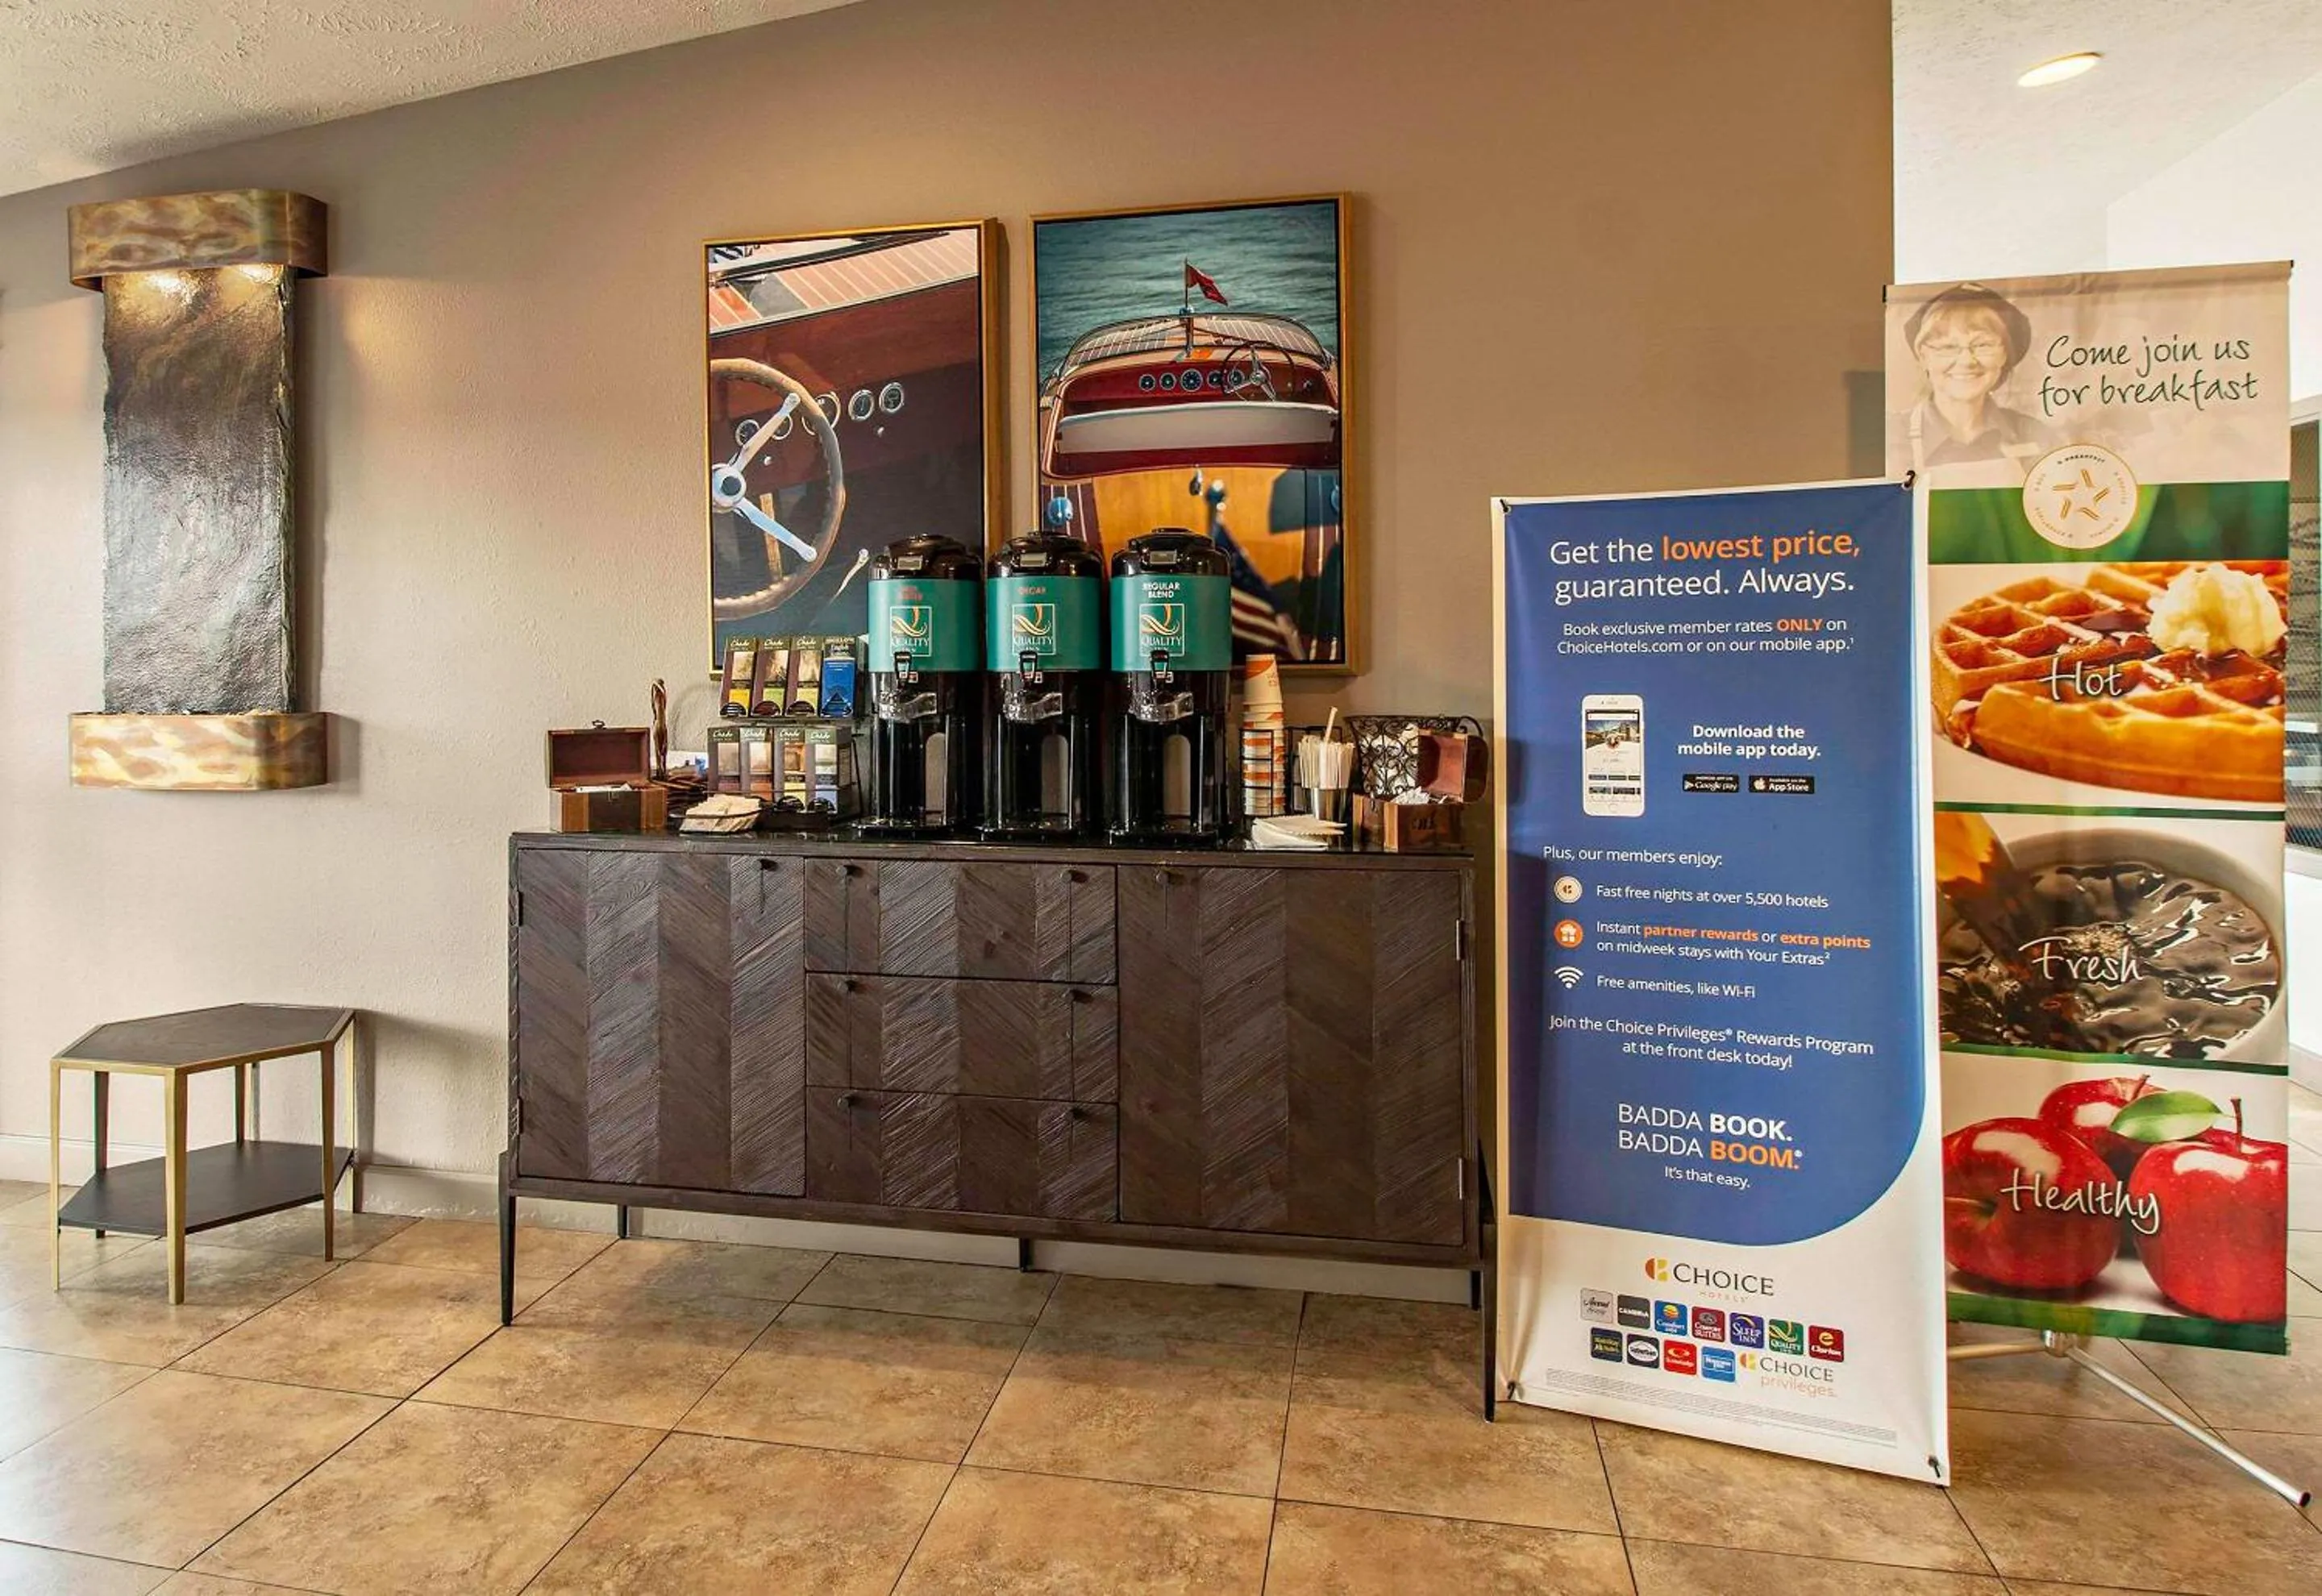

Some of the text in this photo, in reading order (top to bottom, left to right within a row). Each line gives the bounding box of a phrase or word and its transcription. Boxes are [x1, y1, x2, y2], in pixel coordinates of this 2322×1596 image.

[2046, 335, 2251, 378] Come join us
[2038, 368, 2260, 418] for breakfast
[1550, 530, 1861, 564] Get the lowest price,
[1554, 568, 1854, 605] guaranteed. Always.
[1563, 618, 1846, 636] Book exclusive member rates ONLY on
[1141, 636, 1181, 646] QUALITY
[1558, 639, 1683, 655] ChoiceHotels.com
[1687, 642, 1703, 653] or
[1707, 641, 1727, 652] on
[1731, 640, 1755, 651] our
[1759, 637, 1811, 650] mobile
[2041, 655, 2124, 699] Hot
[1693, 725, 1804, 738] Download the
[1678, 742, 1821, 760] mobile app today.
[1769, 783, 1809, 792] App Store
[1543, 846, 1723, 869] Plus, our members enjoy:
[1597, 885, 1829, 908] Fast free nights at over 5,500 hotels
[1596, 921, 1871, 950] Instant partner rewards or extra points
[1596, 941, 1613, 952] on
[1617, 940, 1675, 956] midweek
[1678, 944, 1712, 959] stays
[1714, 946, 1743, 960] with
[1746, 948, 1779, 962] Your
[2018, 936, 2145, 985] Fresh
[1596, 975, 1756, 999] Free amenities, like Wi-Fi
[1550, 1015, 1575, 1030] Join
[1579, 1017, 1602, 1031] the
[1606, 1020, 1654, 1035] Choice
[1737, 1031, 1801, 1049] Rewards
[1805, 1037, 1874, 1058] Program
[1622, 1041, 1792, 1071] at the front desk today!
[1618, 1103, 1793, 1142] BADDA BOOK.
[1618, 1130, 1703, 1158] BADDA
[1665, 1166, 1750, 1191] It's that easy.
[2000, 1166, 2162, 1236] Healthy
[1673, 1263, 1775, 1296] CHOICE
[1733, 1323, 1762, 1338] SLEEP
[1739, 1334, 1756, 1344] INN
[1811, 1345, 1841, 1356] Clarion
[1760, 1357, 1833, 1382] CHOICE
